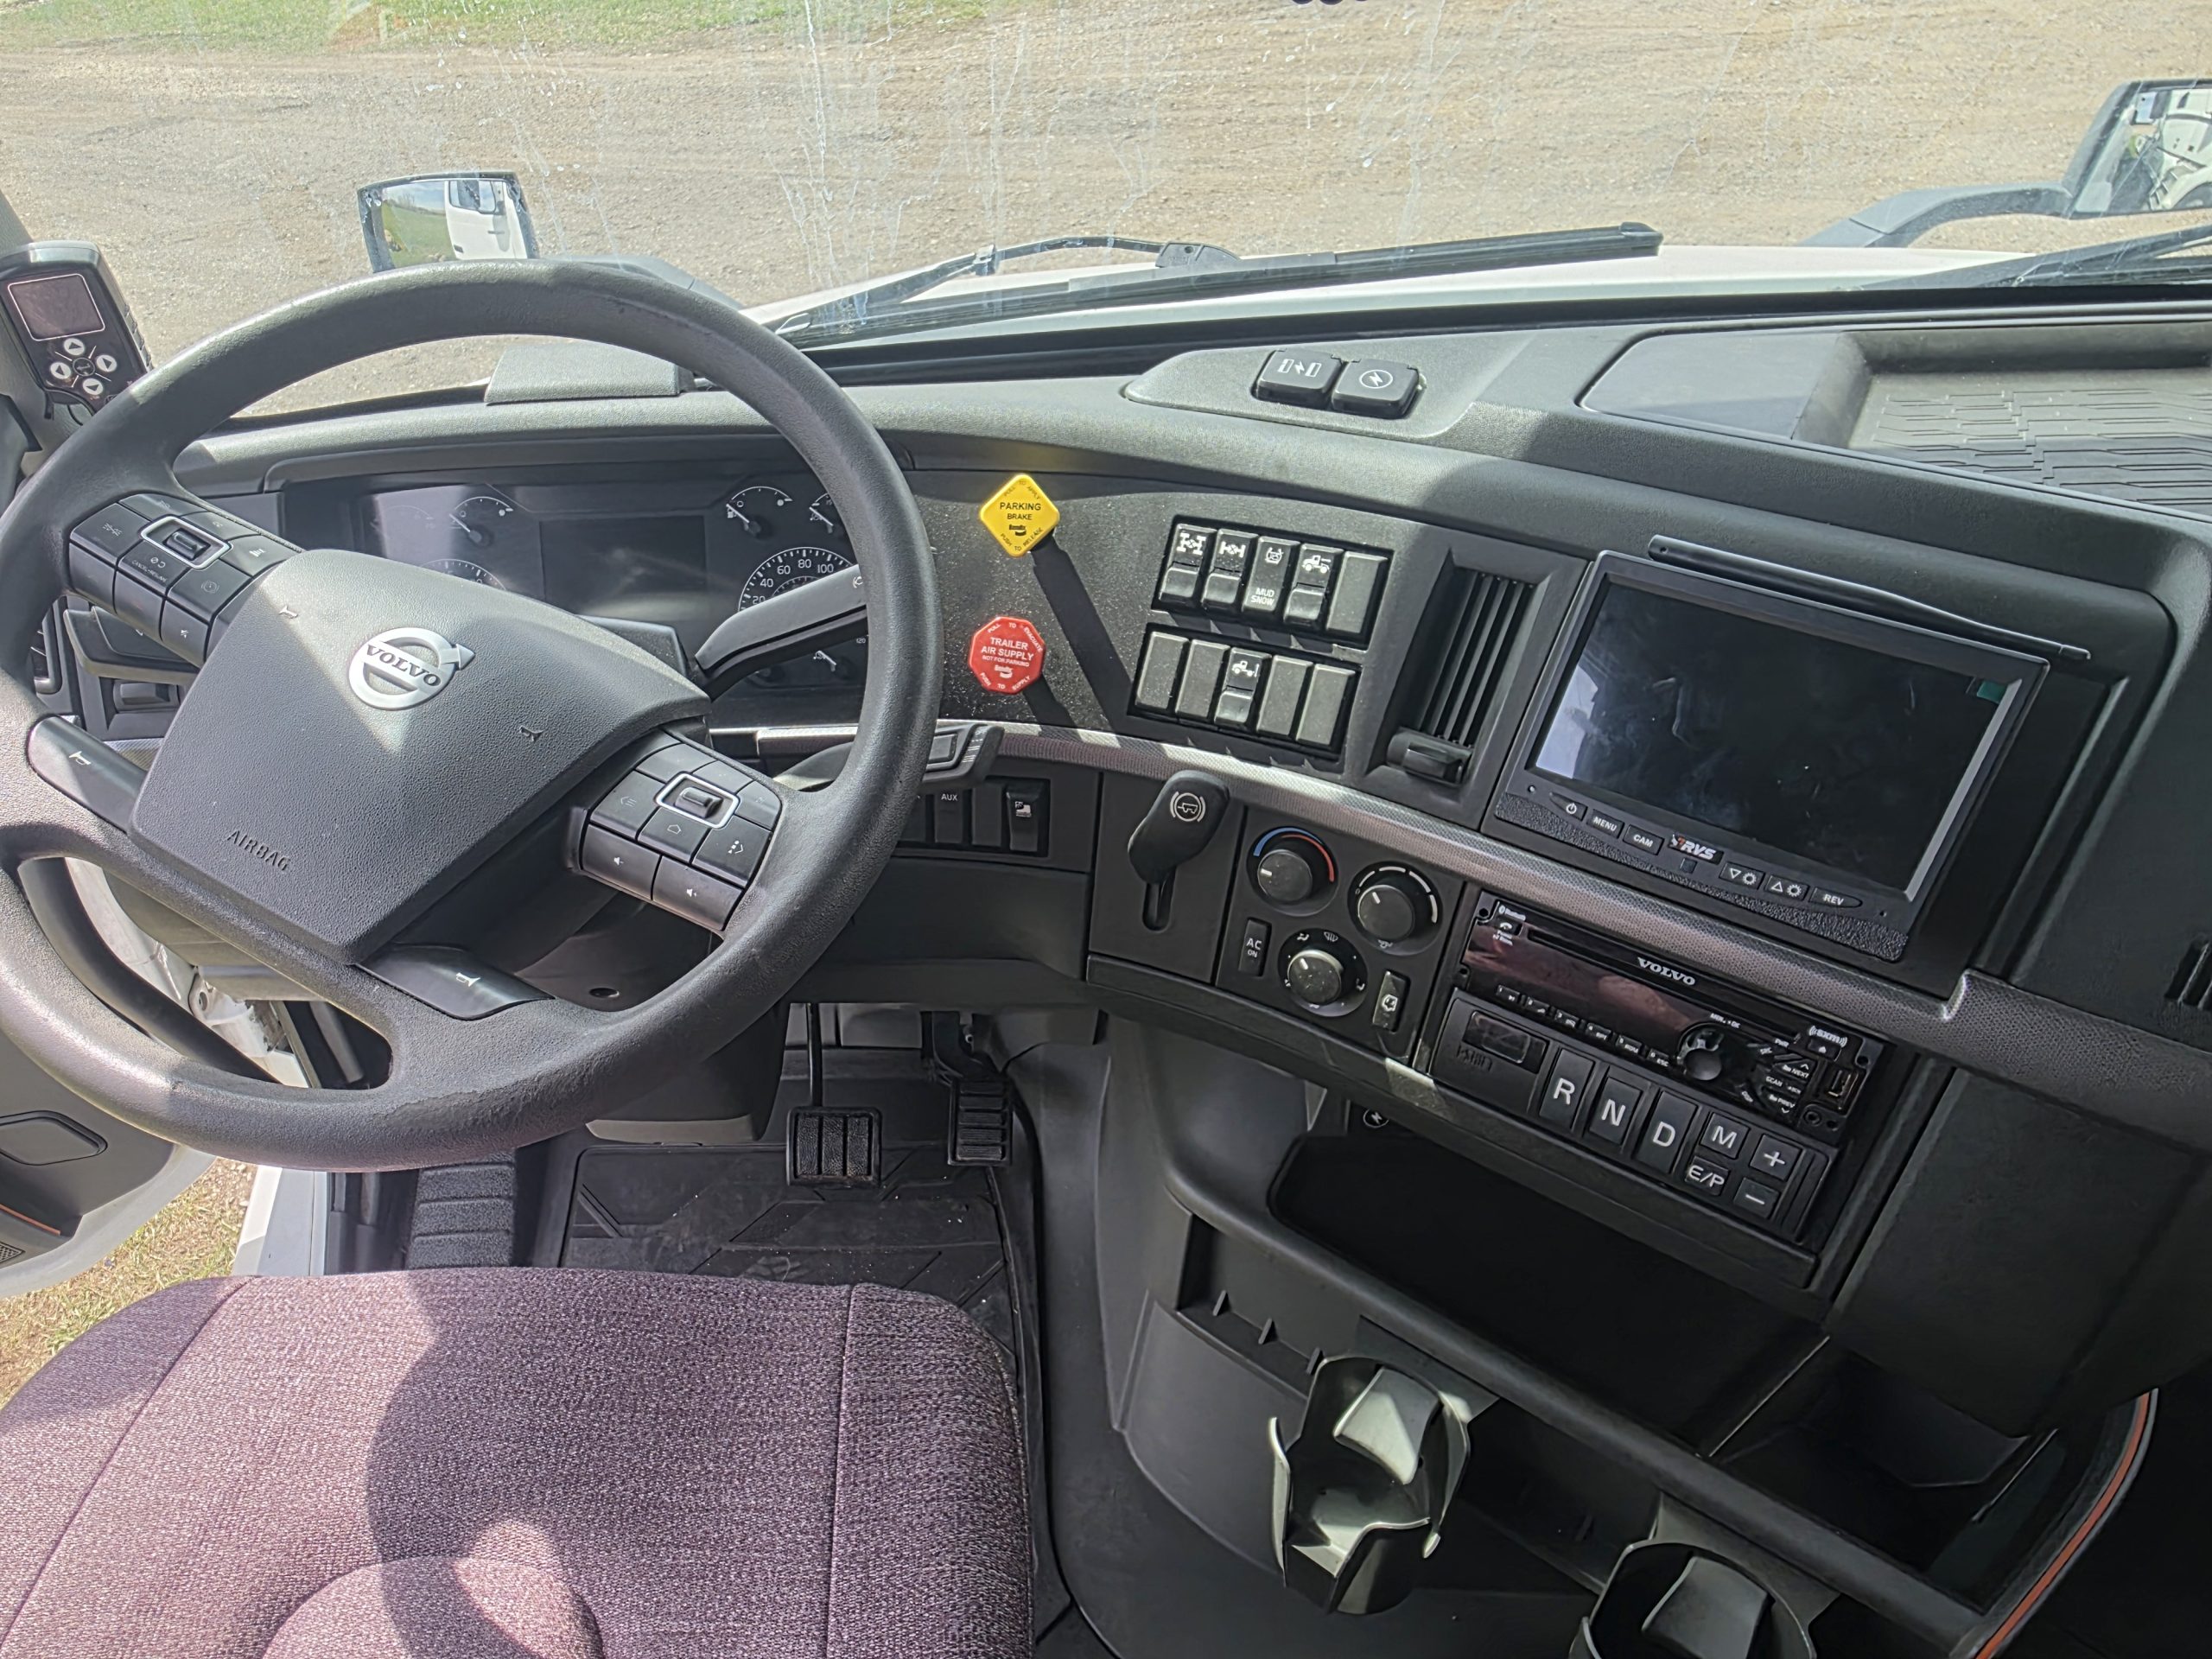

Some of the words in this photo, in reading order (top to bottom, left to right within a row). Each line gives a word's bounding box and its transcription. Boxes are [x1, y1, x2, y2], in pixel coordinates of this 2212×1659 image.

[999, 502, 1041, 512] PARKING
[1007, 512, 1033, 521] BRAKE
[1000, 532, 1014, 548] PUSH
[777, 564, 791, 575] 60
[798, 558, 812, 569] 80
[817, 563, 835, 574] 100
[760, 578, 774, 588] 40
[1255, 587, 1275, 598] MUD
[752, 595, 766, 605] 20
[1250, 594, 1275, 607] SNOW
[989, 637, 1029, 651] TRAILER
[981, 645, 997, 655] AIR
[997, 648, 1034, 662] SUPPLY
[366, 644, 442, 686] VOLVO
[1005, 658, 1030, 668] PARKING
[1012, 676, 1031, 691] SUPPLY
[1593, 817, 1618, 831] MENU
[1633, 834, 1654, 848] CAM
[226, 830, 291, 871] AIRBAG
[1681, 840, 1716, 860] RVS
[1823, 893, 1844, 906] REV
[1246, 938, 1262, 950] AC
[1247, 950, 1258, 958] ON
[1637, 957, 1695, 985] VOLVO
[1791, 1068, 1809, 1079] NEXT
[1765, 1076, 1783, 1087] SCAN
[1553, 1077, 1575, 1105] R
[1777, 1097, 1796, 1109] PREV
[1601, 1098, 1626, 1127] N
[1652, 1121, 1676, 1147] D
[1712, 1125, 1738, 1149] M
[1688, 1165, 1725, 1187] E/P
